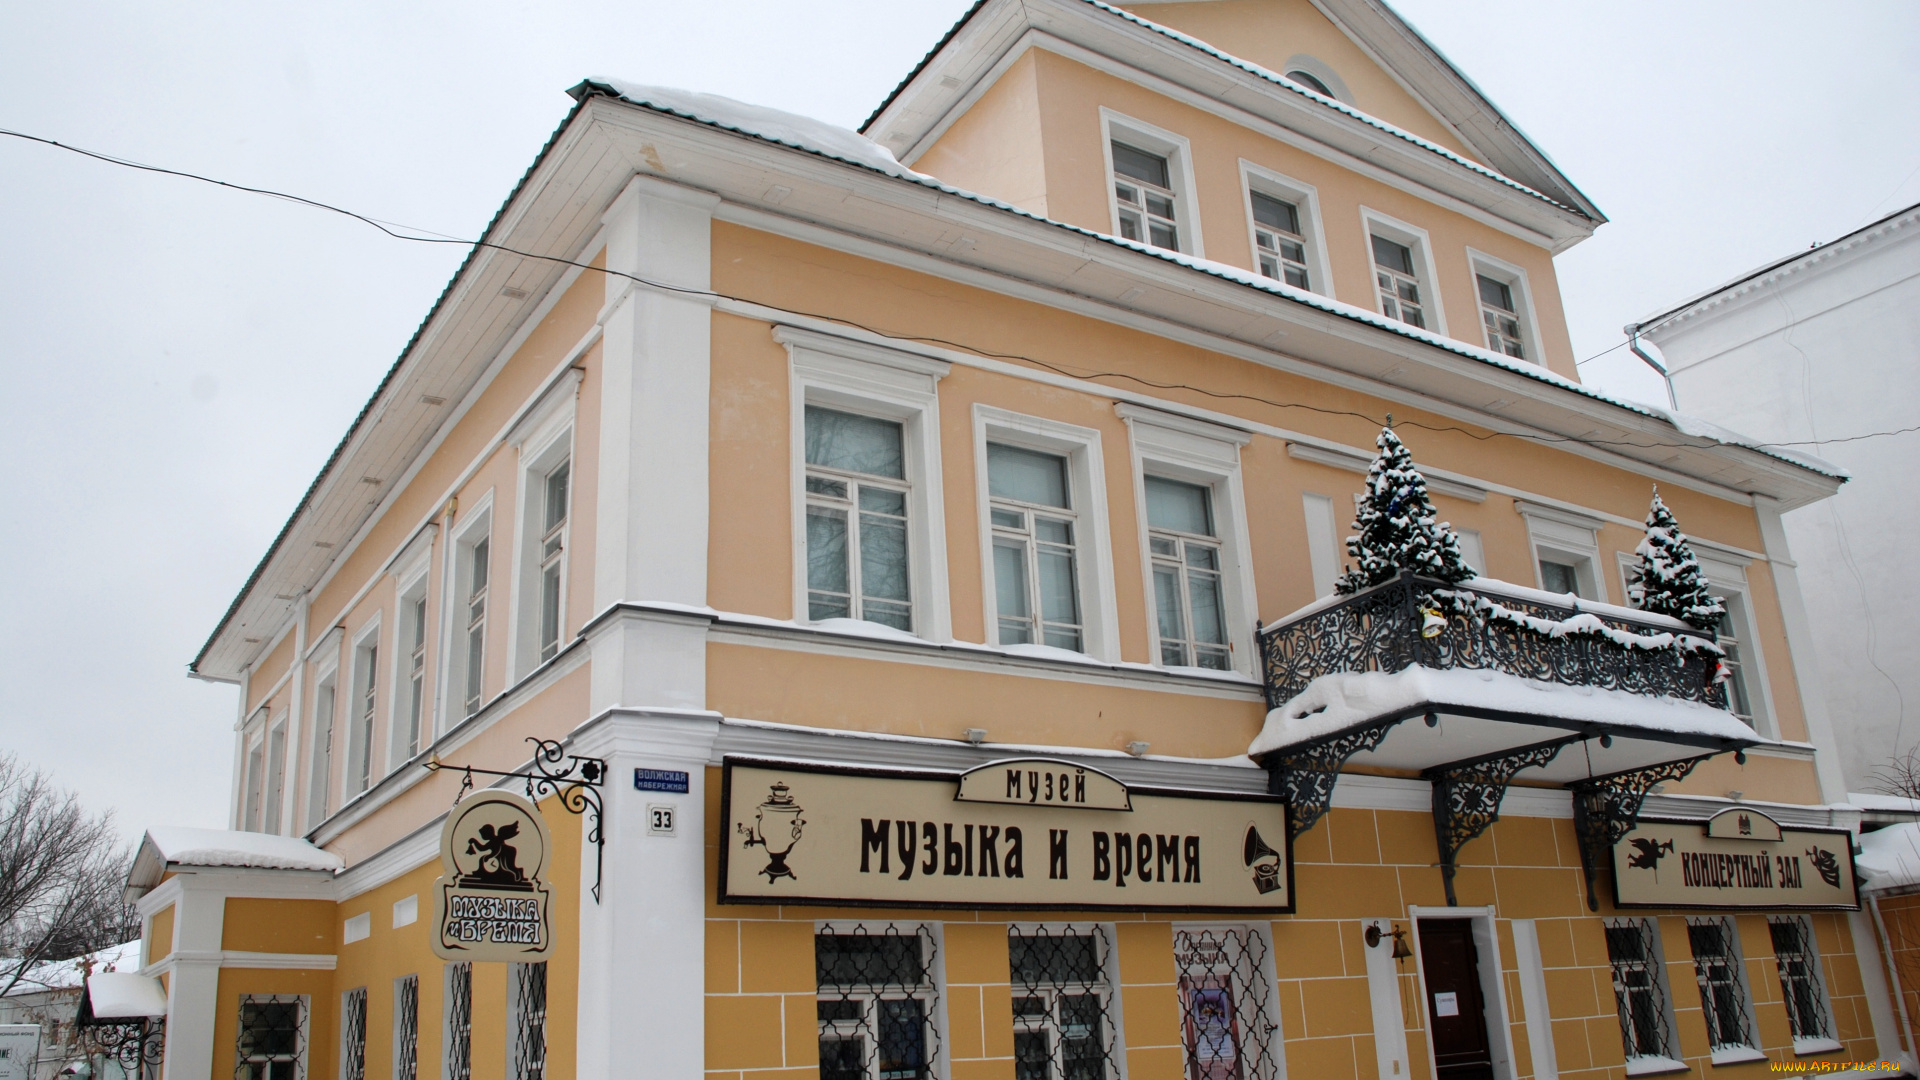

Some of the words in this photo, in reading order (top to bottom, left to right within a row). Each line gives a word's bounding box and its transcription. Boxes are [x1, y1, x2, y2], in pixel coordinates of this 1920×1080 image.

[637, 781, 687, 791] НАБЕРЕЖНАЯ
[638, 770, 686, 782] ВОЛЖСКАЯ
[653, 810, 672, 828] 33
[1681, 850, 1774, 890] КОНЦЕРТНЫЙ
[1777, 855, 1803, 889] ЗАЛ
[451, 895, 540, 920] МУЗЫКА
[459, 919, 540, 944] ВРЕМЯ
